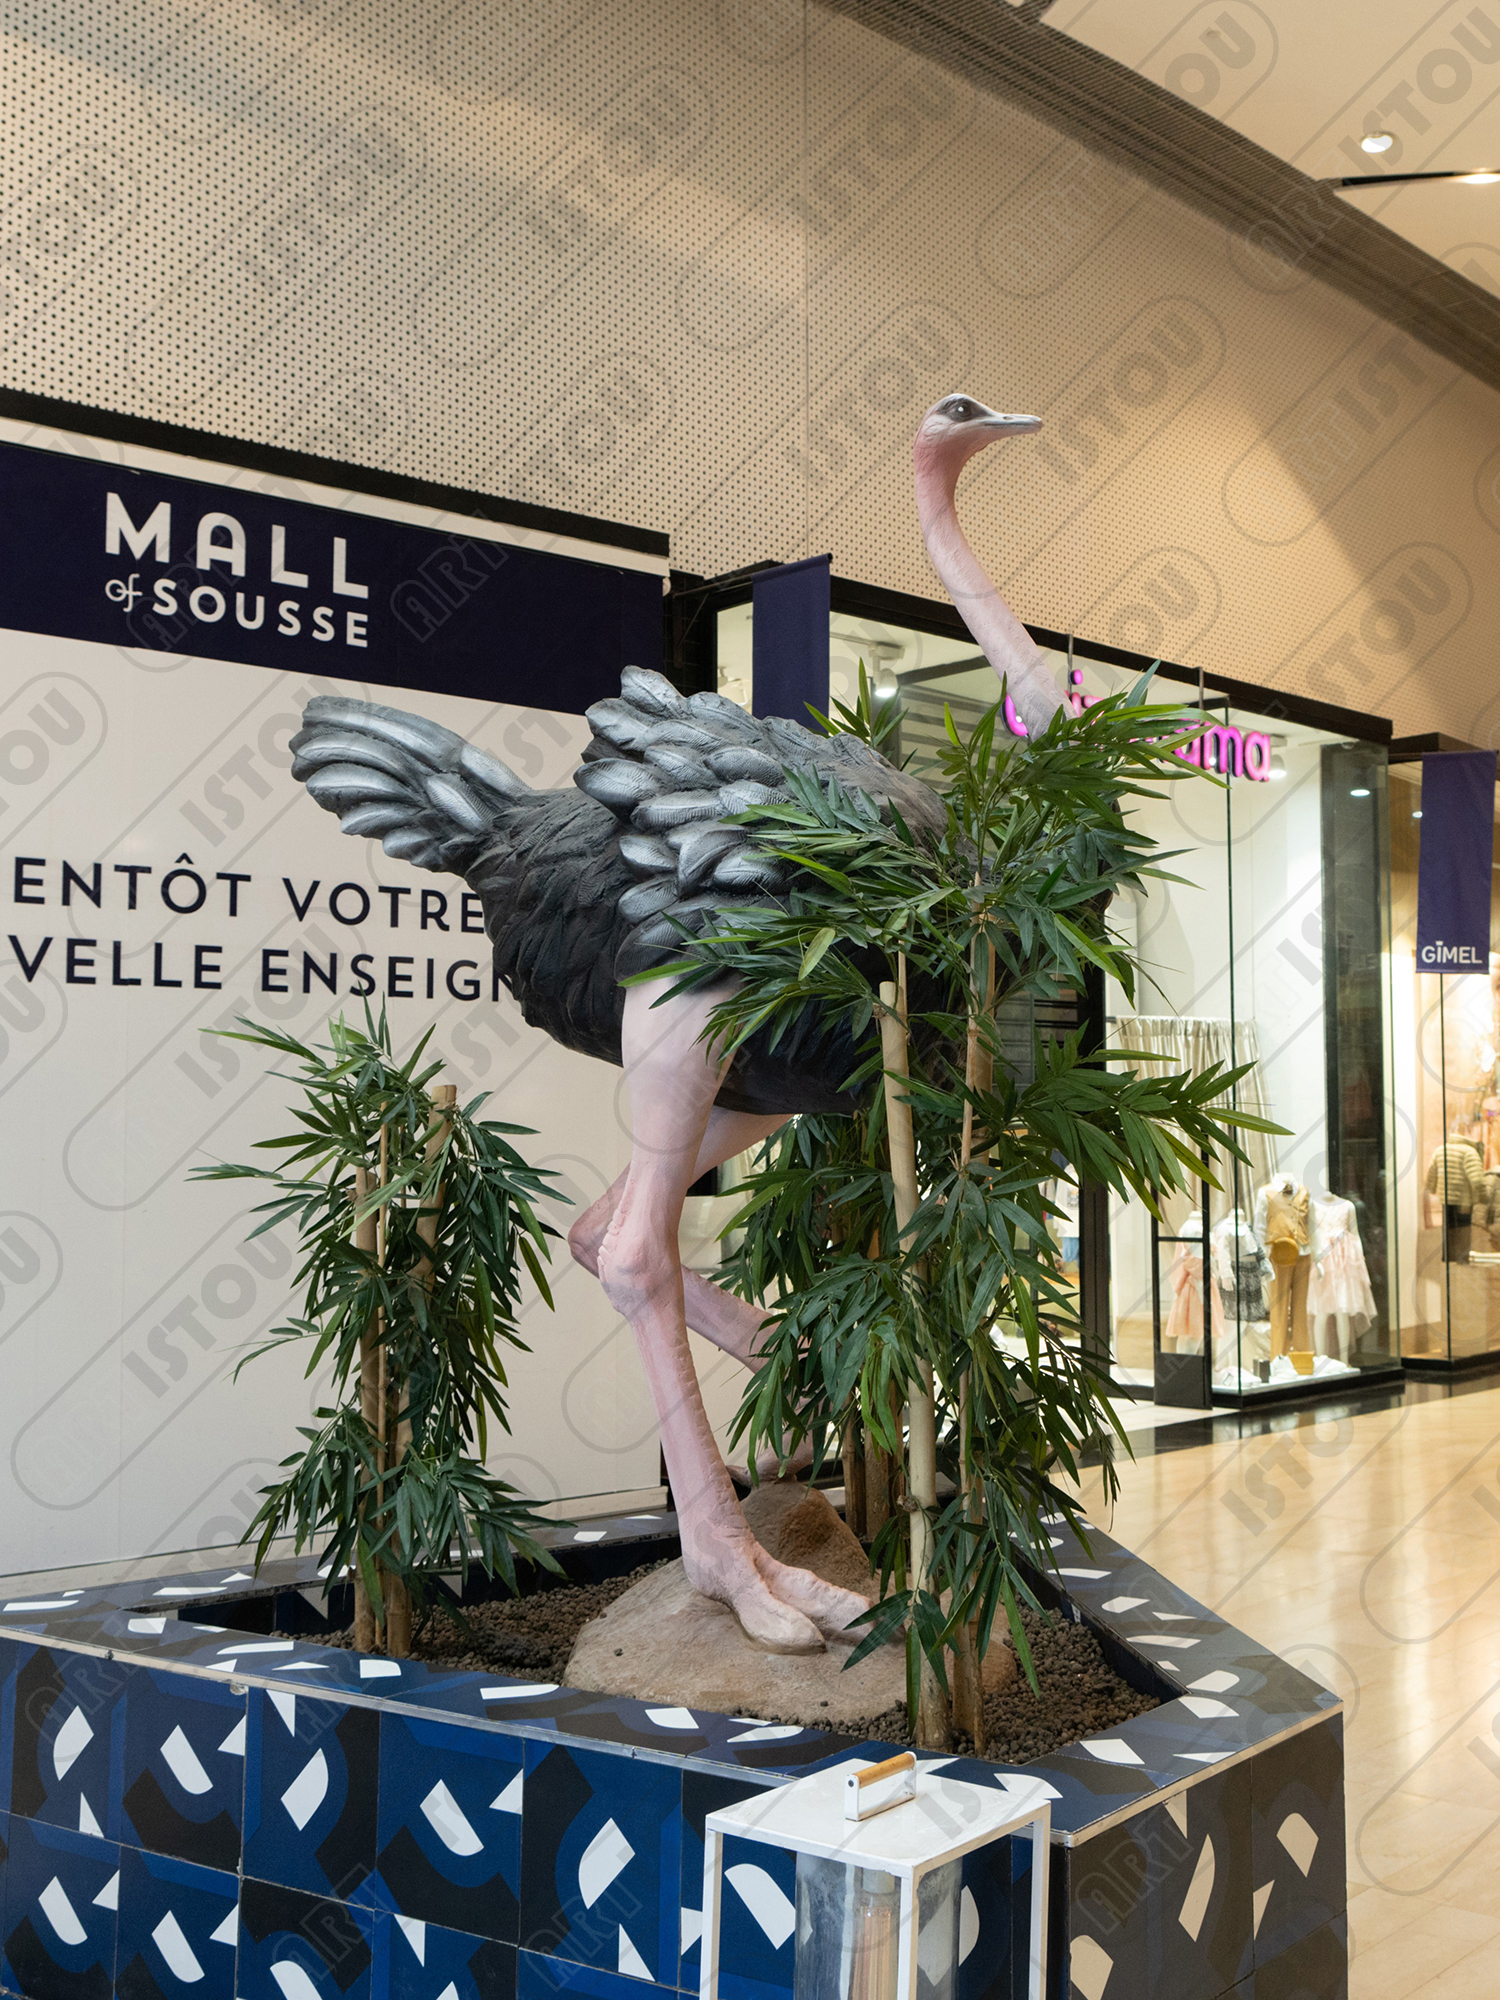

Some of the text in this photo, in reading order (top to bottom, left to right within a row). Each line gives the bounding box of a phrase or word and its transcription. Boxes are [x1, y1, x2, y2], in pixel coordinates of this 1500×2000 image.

[105, 491, 369, 600] MALL
[105, 573, 369, 648] of SOUSSE
[13, 852, 485, 934] ENTÔT VOTRE
[7, 934, 223, 990] VELLE
